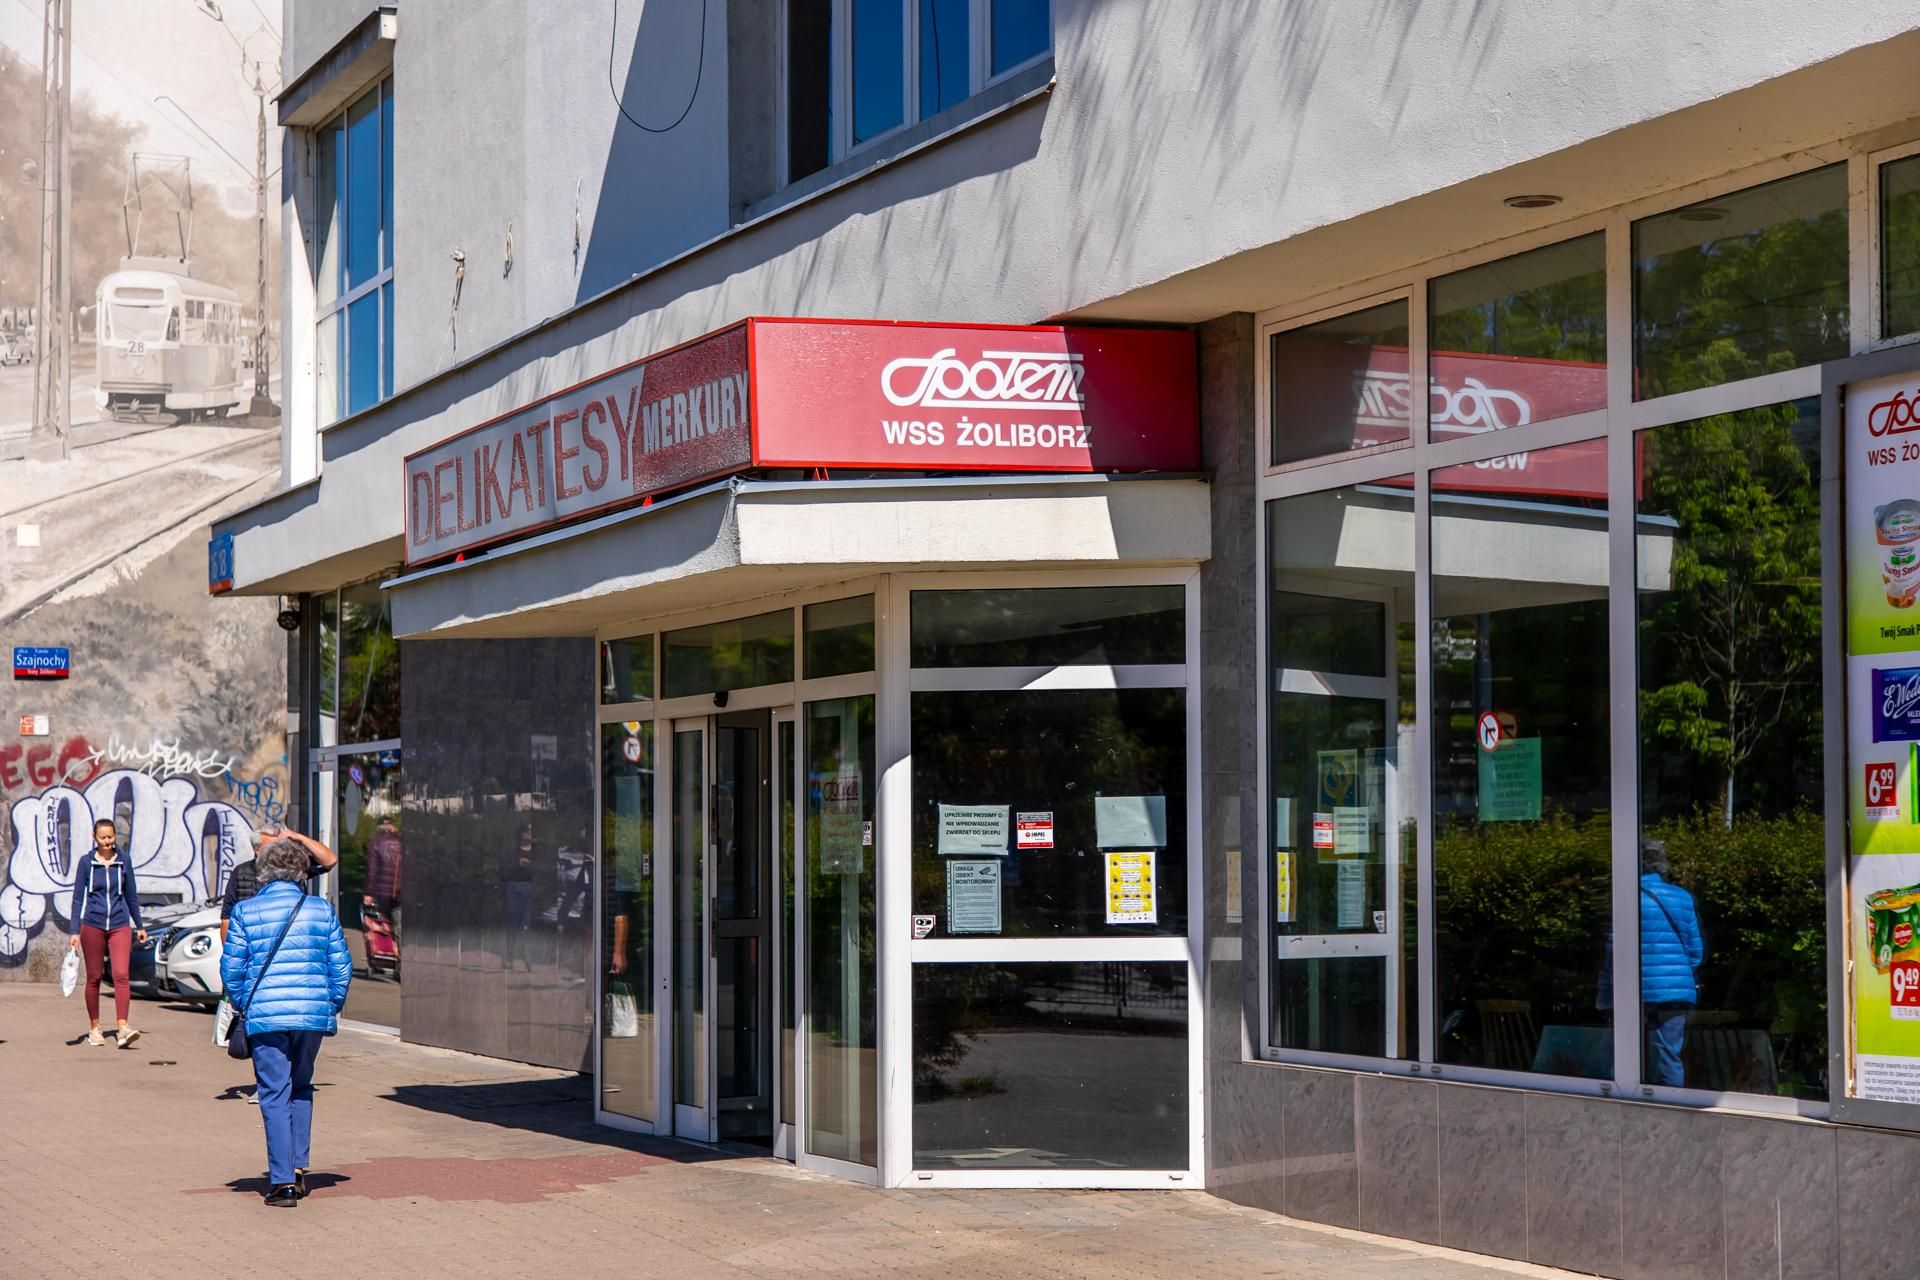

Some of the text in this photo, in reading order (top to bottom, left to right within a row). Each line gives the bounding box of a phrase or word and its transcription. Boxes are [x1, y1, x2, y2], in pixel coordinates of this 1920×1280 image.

[127, 340, 145, 353] 28
[882, 416, 1093, 449] WSS ŻOLIBORZ
[412, 370, 750, 546] DELIKATESY MERKURY
[1868, 447, 1896, 467] WSS
[1880, 626, 1896, 640] Twój
[1897, 624, 1916, 637] Smak
[16, 654, 66, 670] Szajnochy
